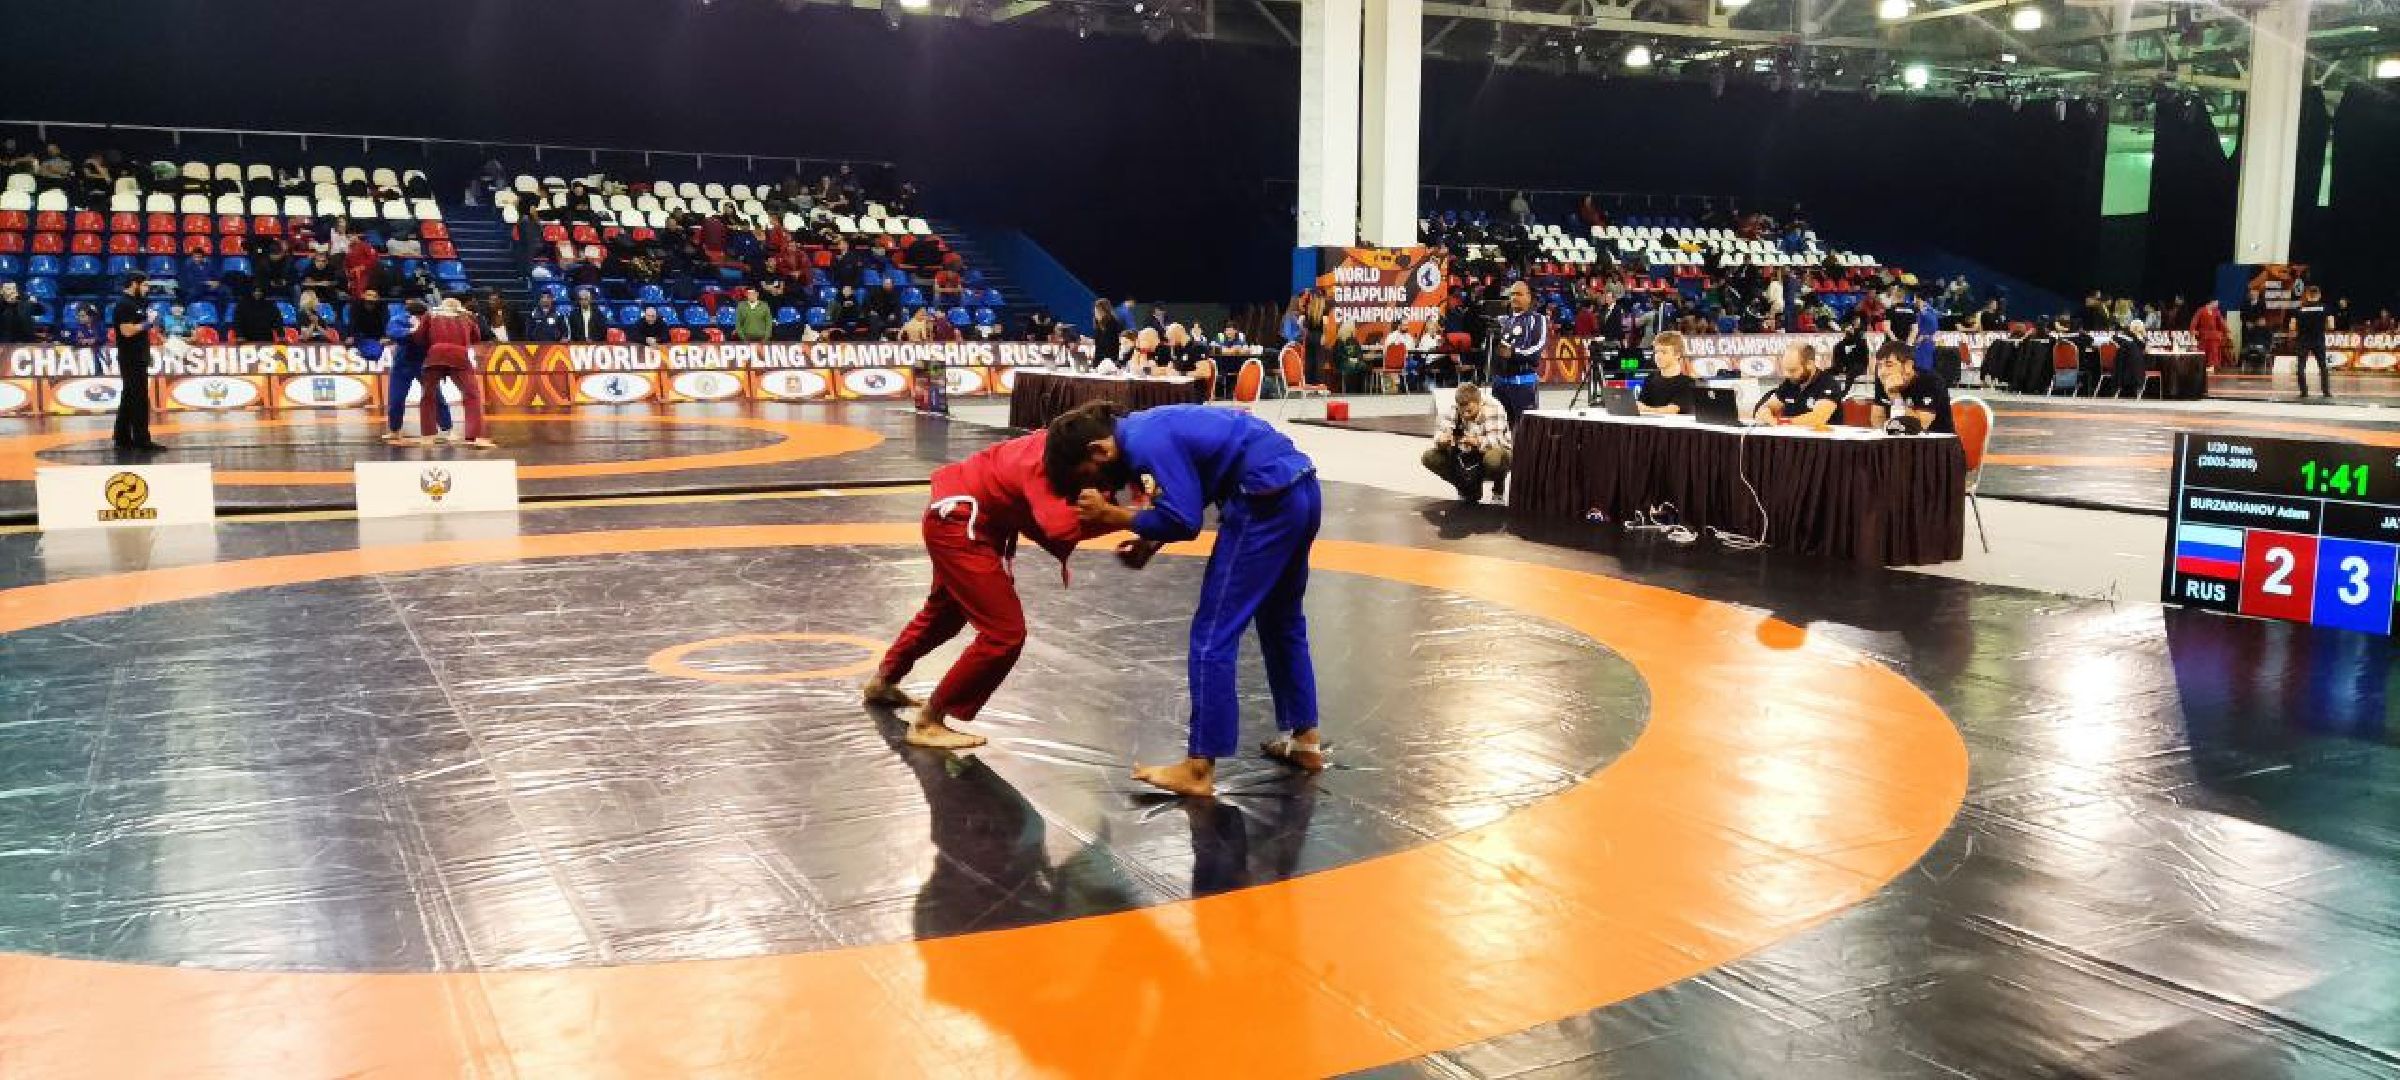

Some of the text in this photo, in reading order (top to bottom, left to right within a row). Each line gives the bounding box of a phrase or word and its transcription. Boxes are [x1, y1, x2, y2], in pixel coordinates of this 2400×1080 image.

[1334, 267, 1380, 283] WORLD
[1334, 286, 1407, 302] GRAPPLING
[1334, 306, 1441, 323] CHAMPIONSHIPS
[569, 345, 662, 370] WORLD
[669, 344, 805, 369] GRAPPLING
[810, 344, 995, 367] CHAMPIONSHIPS
[2301, 460, 2369, 496] 1:41
[2276, 506, 2310, 520] Adam
[2261, 546, 2296, 596] 2
[2337, 555, 2371, 606] 3
[2185, 579, 2226, 601] RUS
